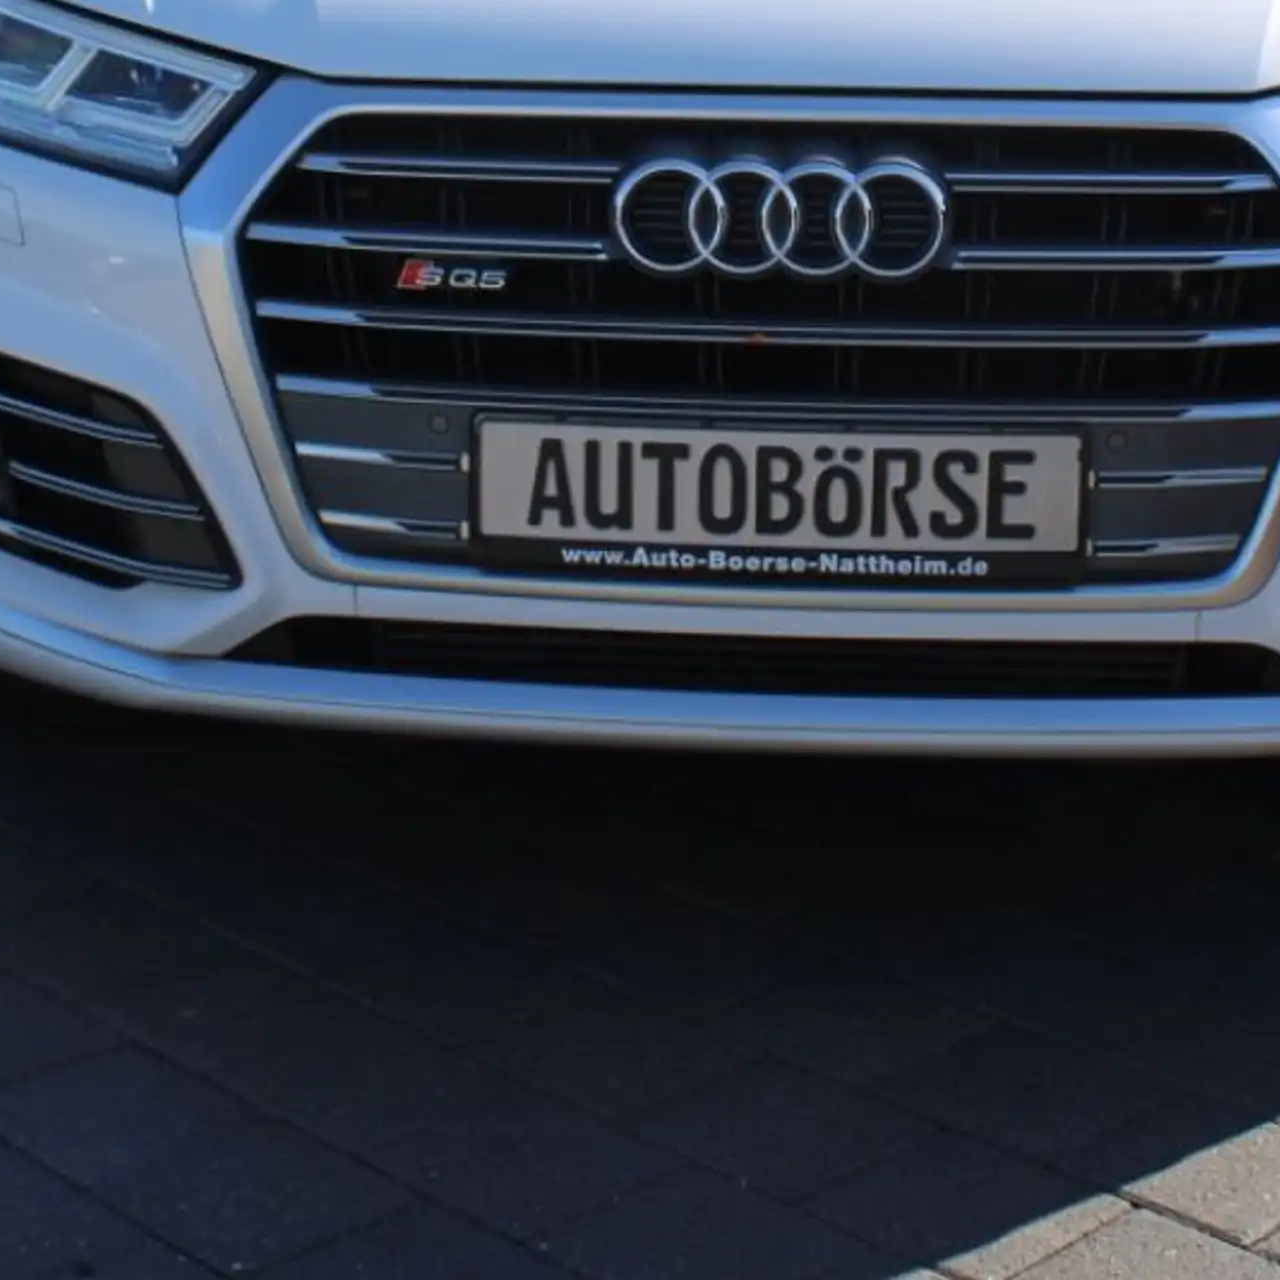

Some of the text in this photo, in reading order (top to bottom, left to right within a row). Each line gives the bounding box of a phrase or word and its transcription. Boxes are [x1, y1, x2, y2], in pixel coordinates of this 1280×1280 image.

[410, 263, 508, 291] SQ5
[527, 437, 1037, 540] AUTOBÖRSE
[561, 546, 989, 577] www.Auto-Boerse-Nattheim.de
